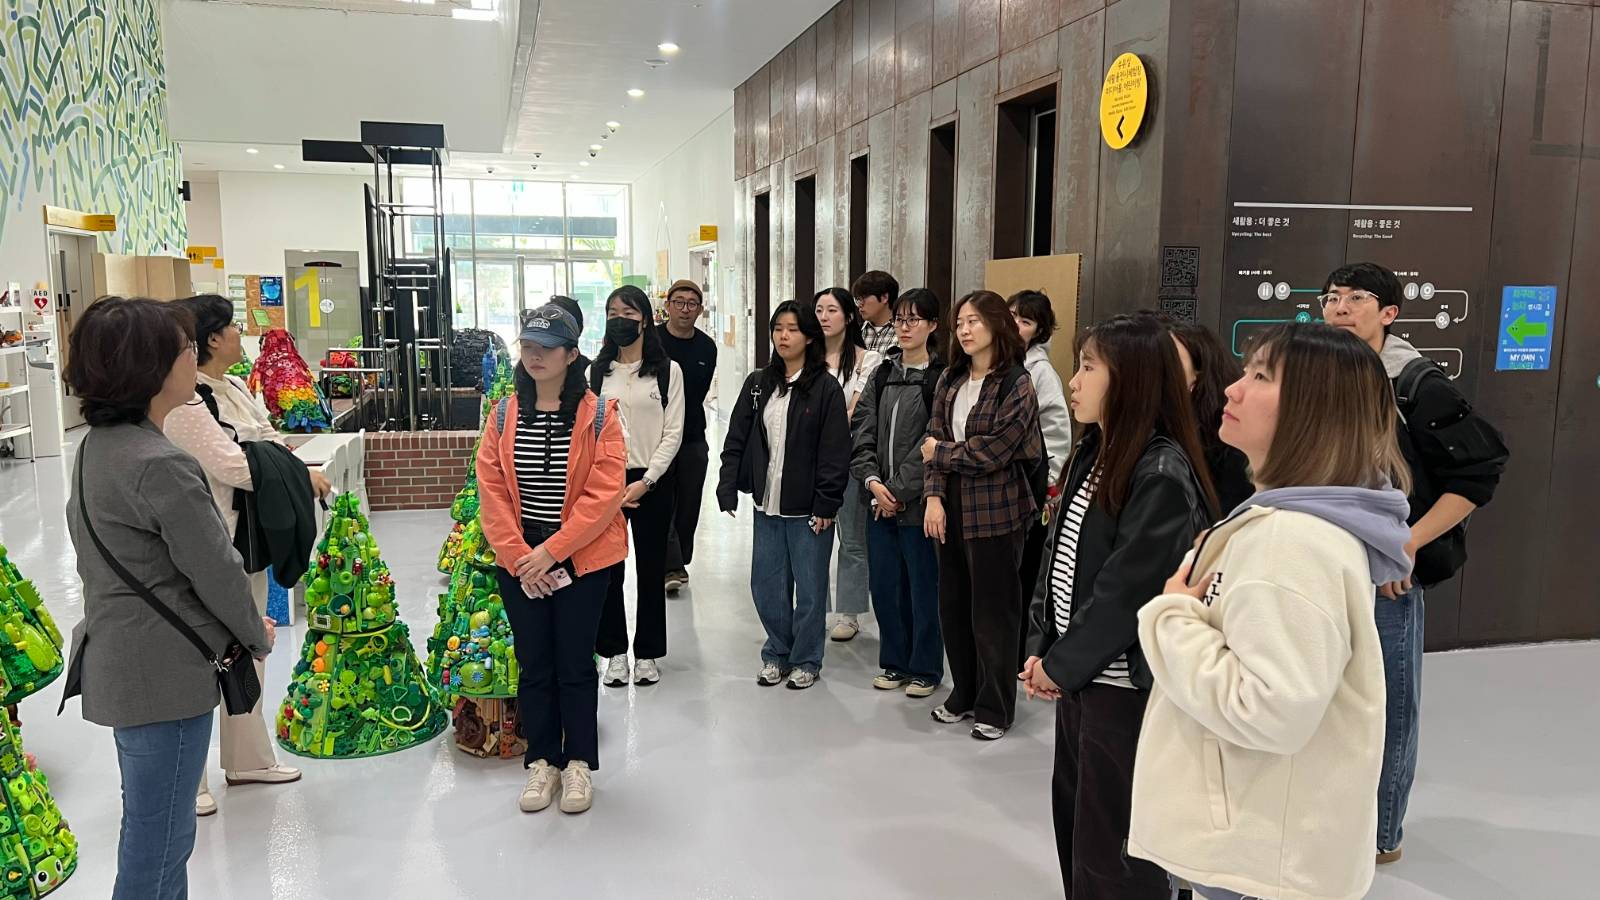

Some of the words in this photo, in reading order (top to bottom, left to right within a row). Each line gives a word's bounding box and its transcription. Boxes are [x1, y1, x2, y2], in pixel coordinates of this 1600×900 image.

[1232, 216, 1253, 226] 새활용
[1258, 217, 1266, 226] 더
[1267, 217, 1281, 227] 좋은
[1282, 217, 1290, 227] 것
[1353, 219, 1374, 229] 재활용
[1379, 219, 1392, 229] 좋은
[1393, 219, 1401, 229] 것
[294, 266, 321, 328] 1
[1520, 354, 1536, 362] OWN
